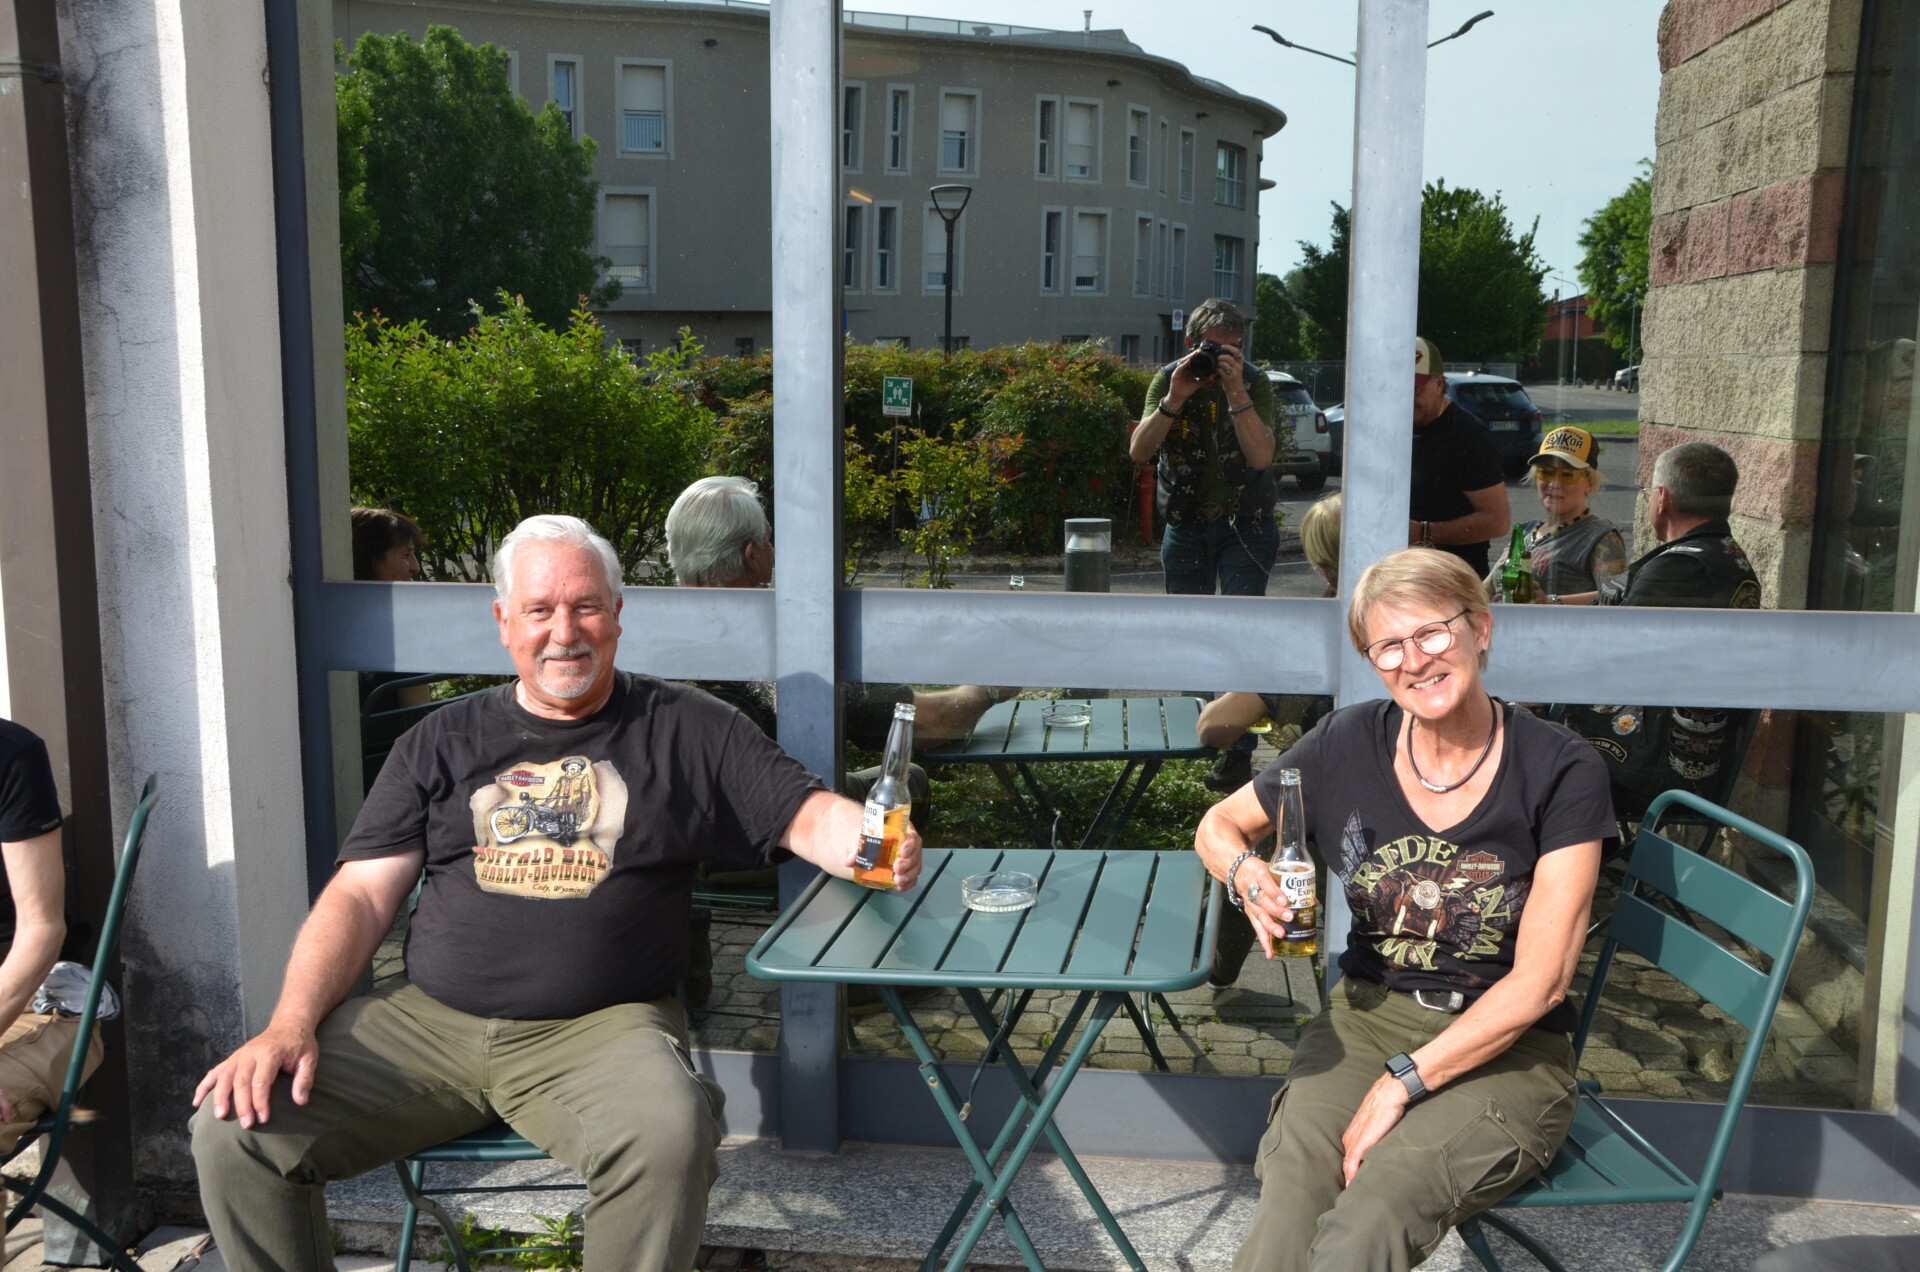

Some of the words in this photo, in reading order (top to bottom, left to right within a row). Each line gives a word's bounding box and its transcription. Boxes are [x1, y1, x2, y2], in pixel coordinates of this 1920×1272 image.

[500, 775, 543, 784] HARLEY-DAVIDSON
[474, 847, 554, 866] BUFFALO
[562, 850, 607, 870] BILL
[1350, 835, 1459, 894] RIDE
[1460, 862, 1501, 871] HARLEY-DAVIDSON
[481, 865, 596, 884] HARLEY-DAVIDSON
[532, 883, 551, 893] Cody,
[553, 885, 586, 896] Wyoming
[1286, 876, 1316, 891] Coron
[1372, 937, 1440, 970] MY
